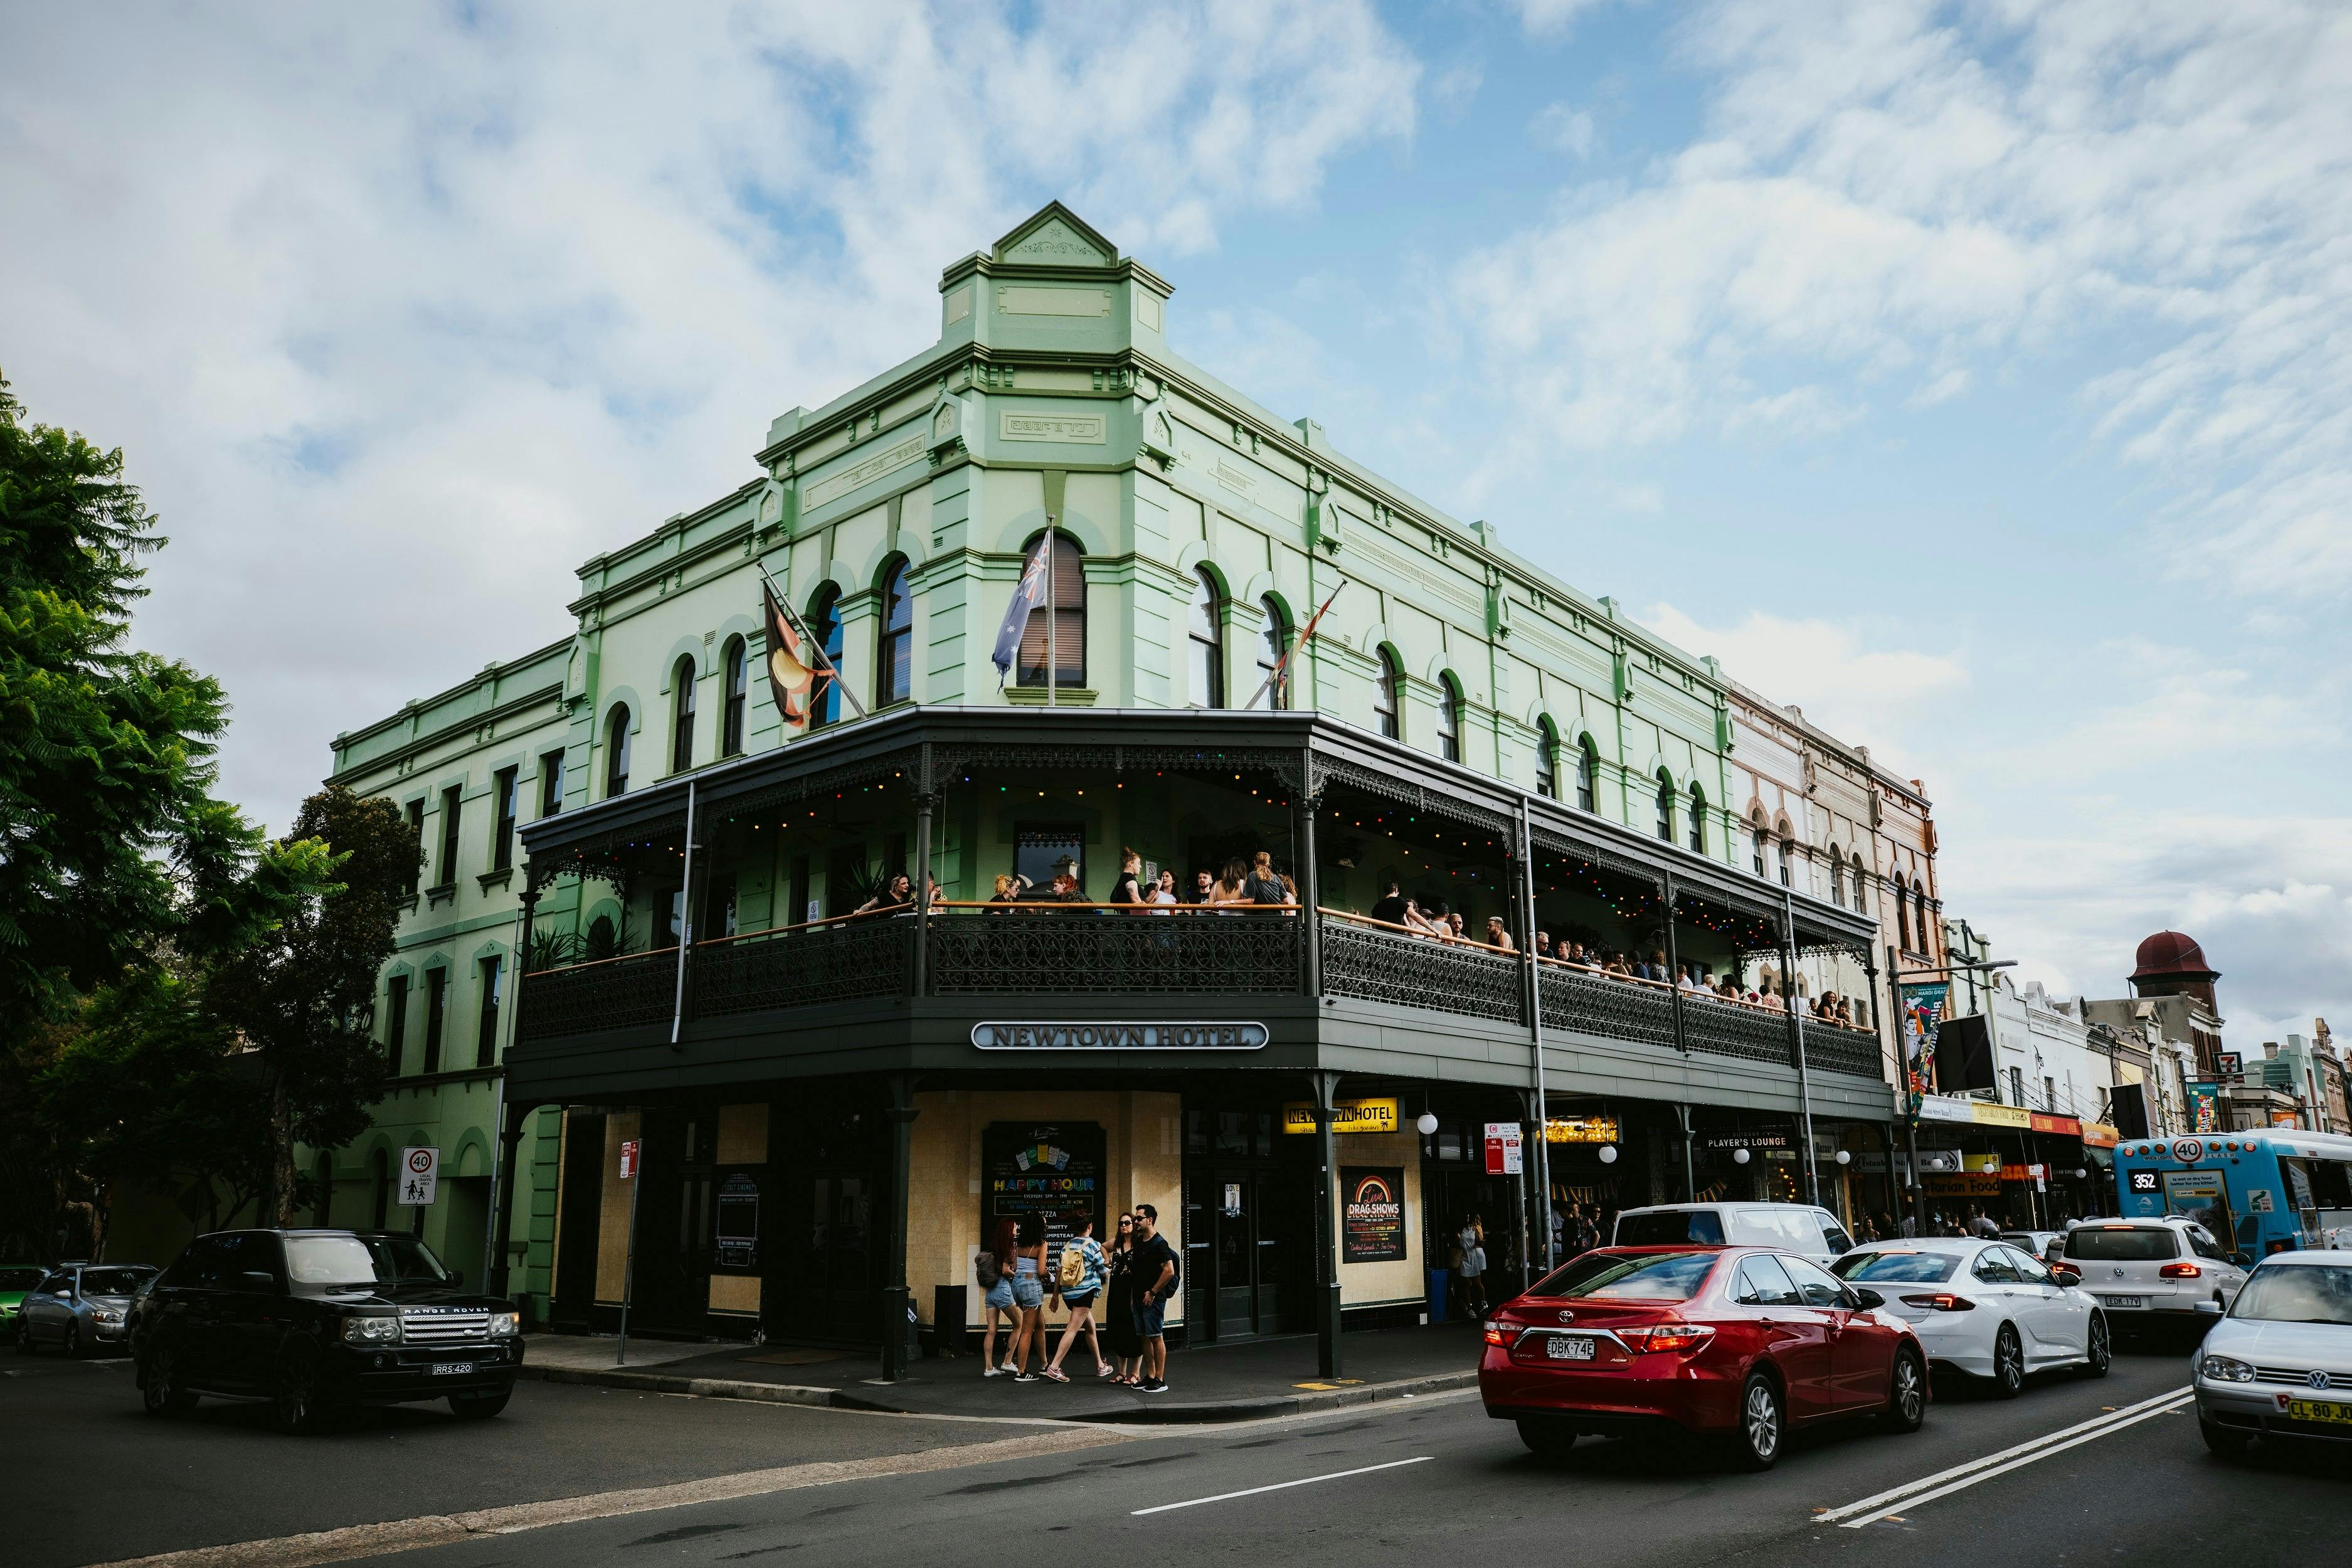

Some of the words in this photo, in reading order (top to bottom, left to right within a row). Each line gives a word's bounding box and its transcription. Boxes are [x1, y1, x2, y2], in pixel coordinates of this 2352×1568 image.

[992, 1026, 1147, 1047] NEWTOWN
[1156, 1026, 1250, 1046] HOTEL
[1290, 1108, 1352, 1123] NEWWN
[1354, 1106, 1393, 1121] HOTEL
[1978, 1107, 1999, 1118] VEGETARIAN
[2000, 1110, 2009, 1119] FOOD
[1708, 1138, 1749, 1147] PLAYER'S
[1752, 1137, 1786, 1146] LOUNGE
[2177, 1143, 2198, 1156] 40
[413, 1156, 428, 1167] 40
[994, 1178, 1048, 1192] HAPPY
[1051, 1178, 1095, 1192] HOUR
[1924, 1180, 1966, 1192] etarian
[1970, 1179, 2000, 1192] Food
[2134, 1173, 2156, 1189] 352
[1364, 1185, 1384, 1204] Live
[1348, 1204, 1370, 1215] DRAG
[1371, 1203, 1399, 1214] SHOWS
[2276, 1394, 2291, 1409] P
